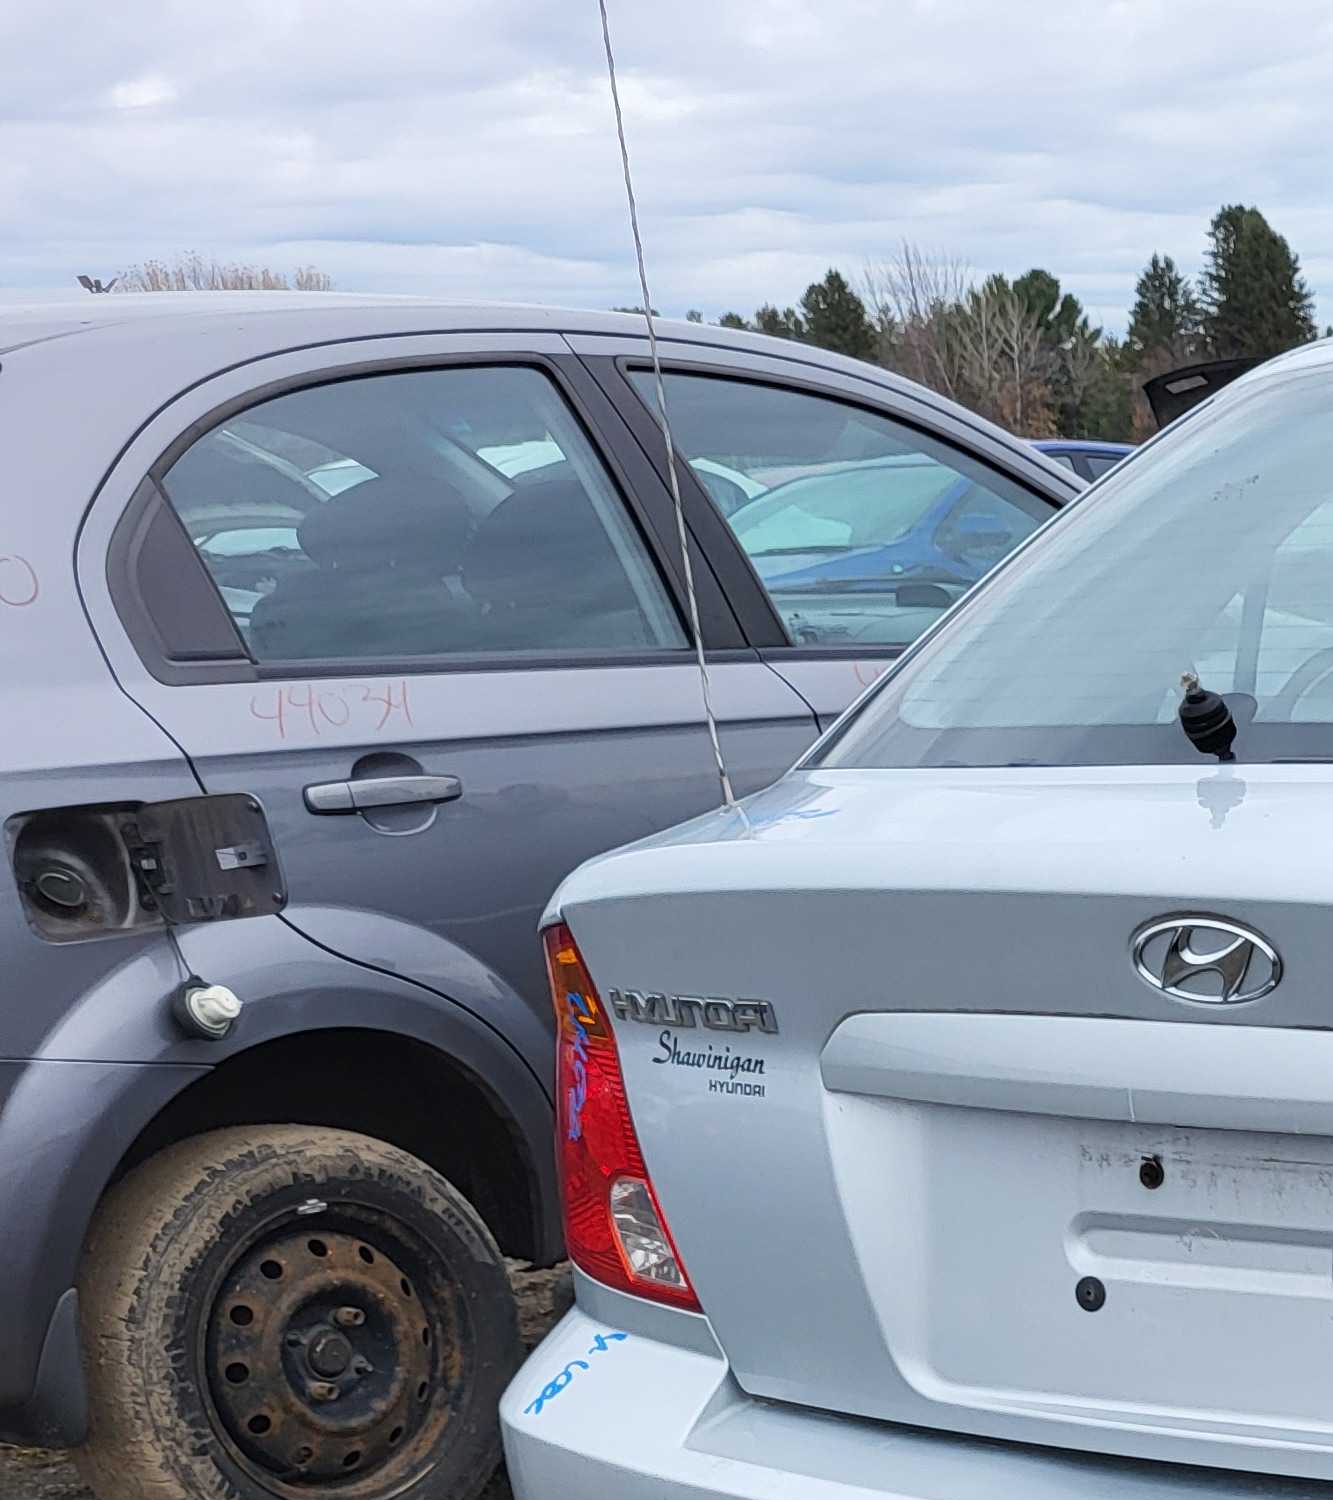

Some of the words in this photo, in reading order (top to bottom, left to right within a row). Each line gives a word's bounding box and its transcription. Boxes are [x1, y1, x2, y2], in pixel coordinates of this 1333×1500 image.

[608, 987, 779, 1034] HYUNDAI
[652, 1029, 766, 1080] Shawinigan
[708, 1079, 766, 1097] HYUNDAI
